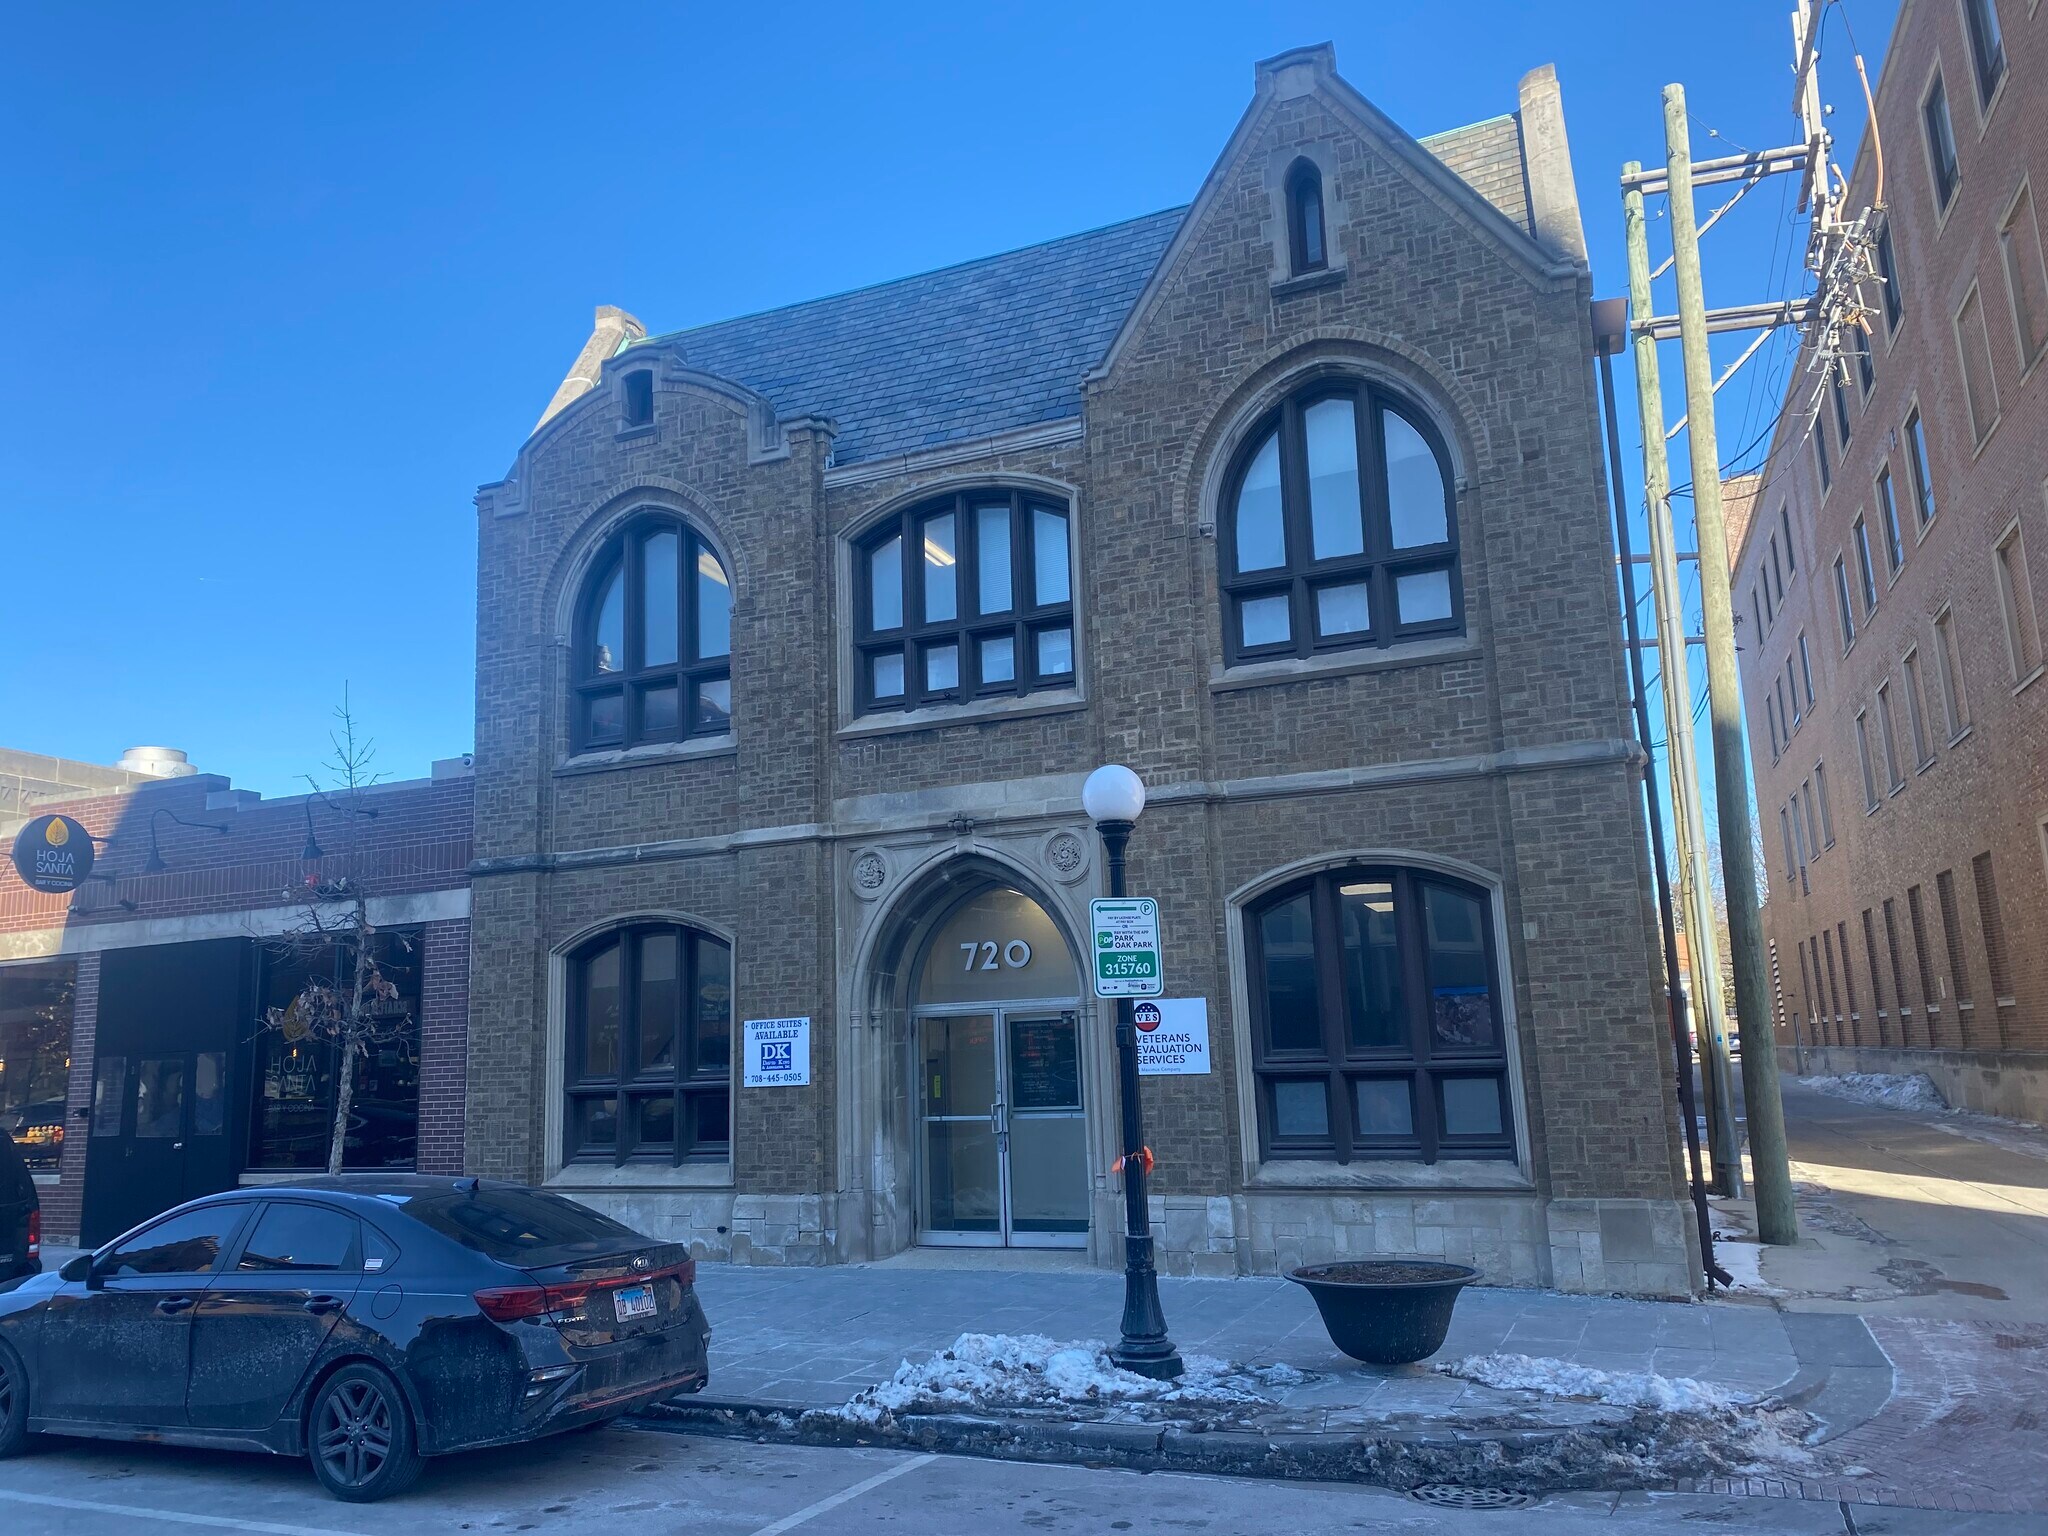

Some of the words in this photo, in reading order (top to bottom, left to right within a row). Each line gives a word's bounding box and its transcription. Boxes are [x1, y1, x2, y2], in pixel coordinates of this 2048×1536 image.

[36, 850, 75, 863] HOJA
[36, 862, 74, 875] SANTA
[1143, 904, 1150, 913] P
[960, 939, 1031, 971] 720
[1117, 955, 1138, 963] ZONE
[1105, 962, 1151, 975] 315760
[1136, 1013, 1158, 1022] VES
[750, 1021, 776, 1030] OFFICE
[777, 1019, 802, 1029] SUITES
[754, 1029, 799, 1040] AVAILABLE
[1136, 1033, 1191, 1044] VETERANS
[762, 1043, 791, 1060] DK
[1137, 1043, 1202, 1054] EVALUATION
[270, 1054, 317, 1073] HOJA
[1137, 1054, 1186, 1065] SERVICES
[270, 1074, 316, 1092] SANTA
[751, 1072, 802, 1083] 708-445-0505
[636, 1258, 648, 1268] KIA
